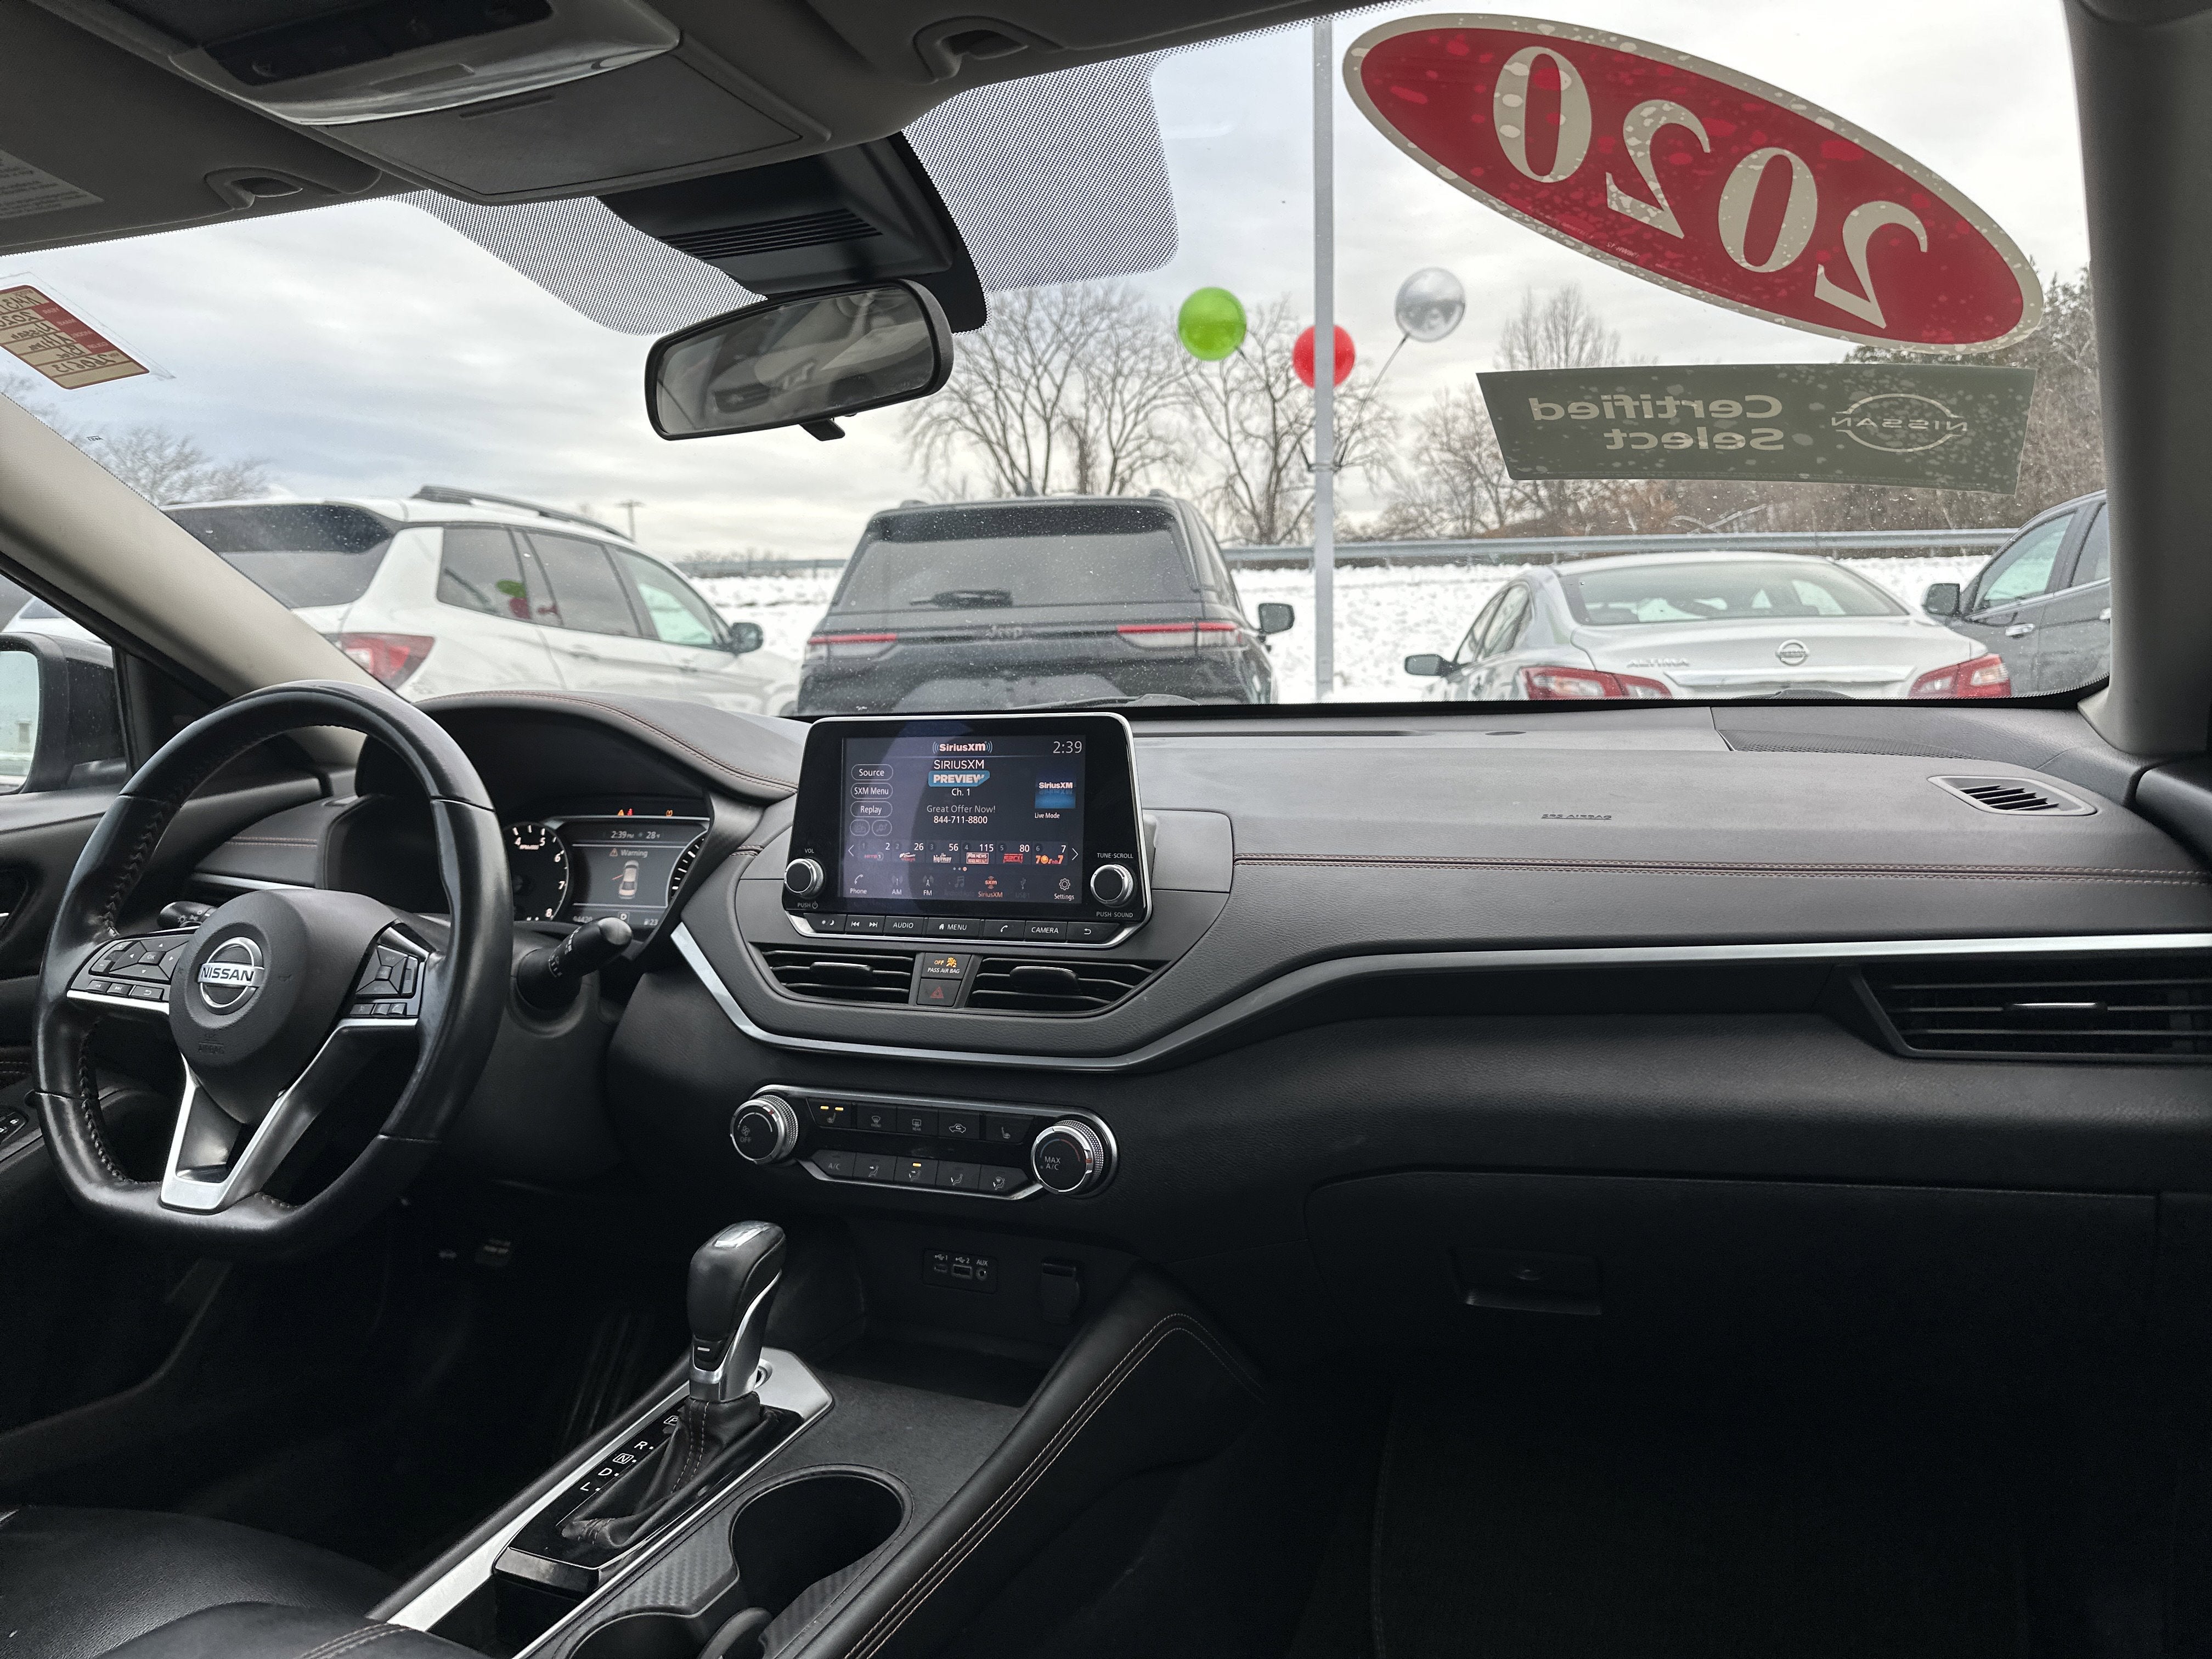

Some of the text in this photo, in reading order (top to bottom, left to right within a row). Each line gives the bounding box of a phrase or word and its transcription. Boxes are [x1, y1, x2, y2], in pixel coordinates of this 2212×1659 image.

[1053, 741, 1082, 754] 2:39
[859, 768, 885, 777] Source
[933, 774, 985, 783] PREVIEW
[854, 787, 889, 795] SXM Menu
[951, 788, 964, 796] Ch.
[860, 805, 882, 815] Replay
[927, 804, 996, 813] Great Offer Now!
[933, 815, 988, 824] 844-711-8800
[611, 831, 627, 839] 2:39
[515, 837, 521, 846] 4
[539, 837, 545, 847] 5
[1019, 844, 1030, 853] 80
[554, 853, 561, 862] 6
[620, 849, 648, 858] Warning
[558, 881, 566, 890] 7
[545, 908, 552, 917] 8
[200, 967, 254, 982] NISSAN
[634, 1441, 647, 1449] R
[598, 1468, 612, 1476] D
[580, 1482, 590, 1491] L
